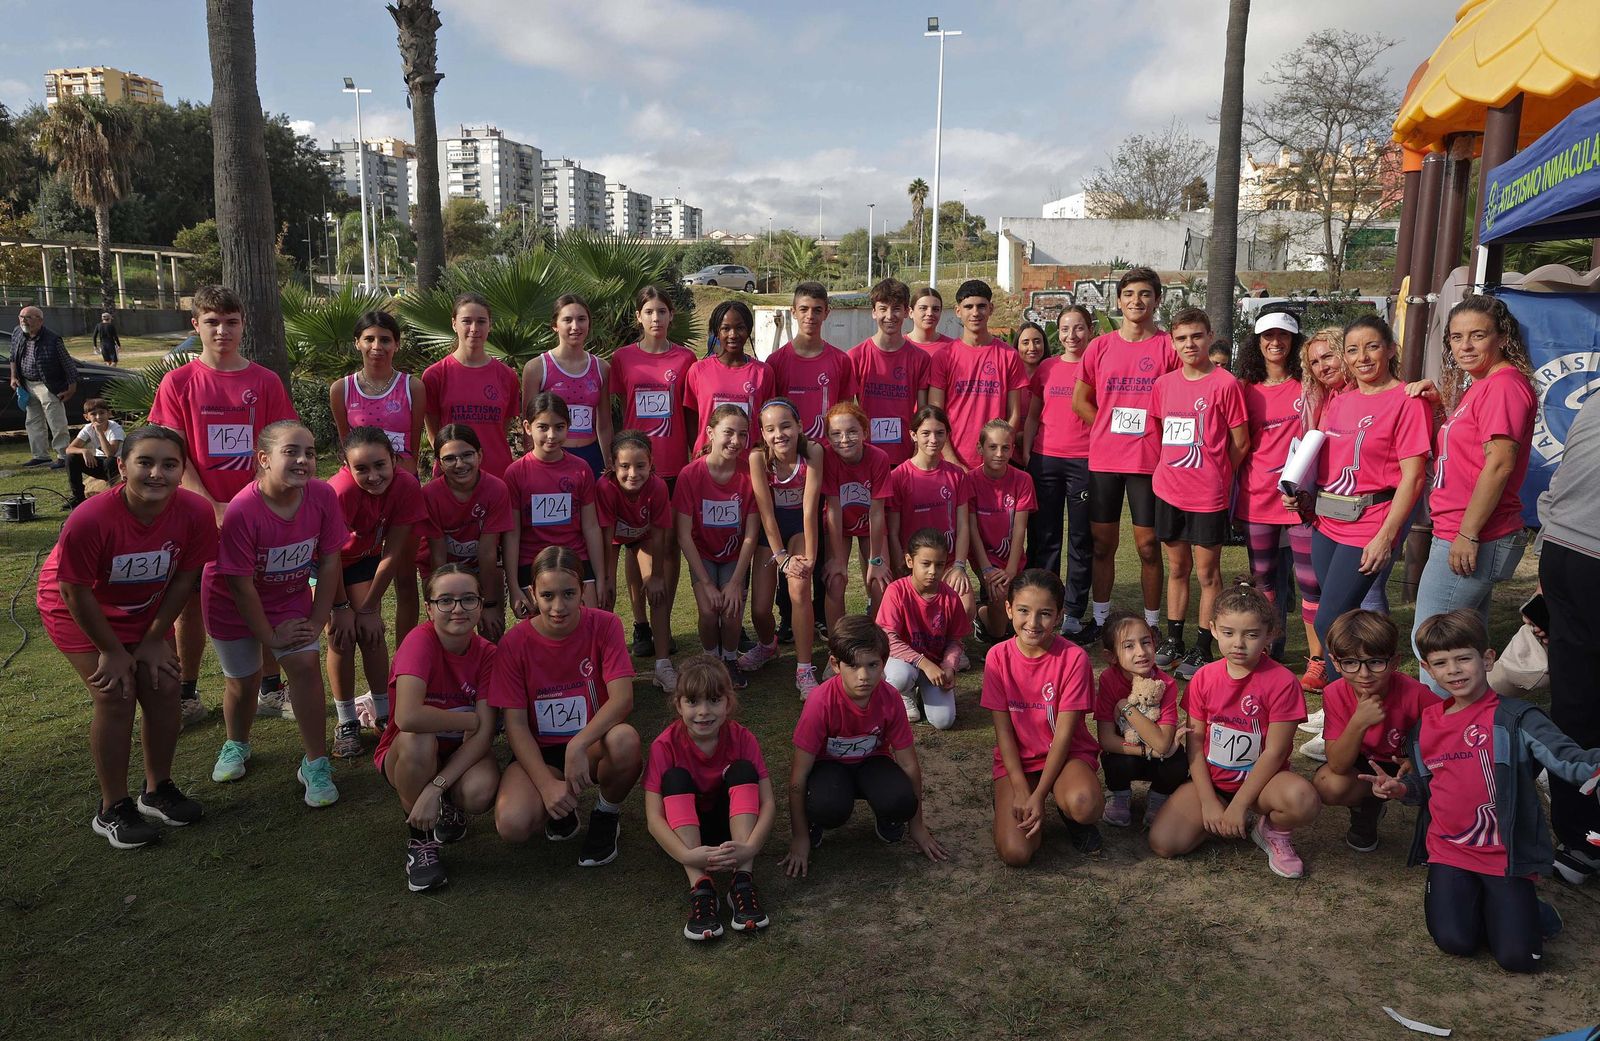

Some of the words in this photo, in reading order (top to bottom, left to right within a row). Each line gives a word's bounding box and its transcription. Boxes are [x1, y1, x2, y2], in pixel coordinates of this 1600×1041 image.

[1498, 166, 1542, 214] ATLETISMO
[865, 382, 910, 392] ATLETISMO
[639, 393, 668, 413] 152
[874, 420, 898, 439] 174
[1115, 410, 1141, 430] 184
[213, 426, 251, 450] 154
[1165, 421, 1192, 441] 175
[536, 496, 568, 519] 124
[708, 505, 737, 523] 125
[273, 543, 310, 568] 142
[120, 555, 162, 578] 131
[536, 680, 587, 696] INMACULADA
[543, 699, 582, 728] 134
[1223, 734, 1253, 762] 12
